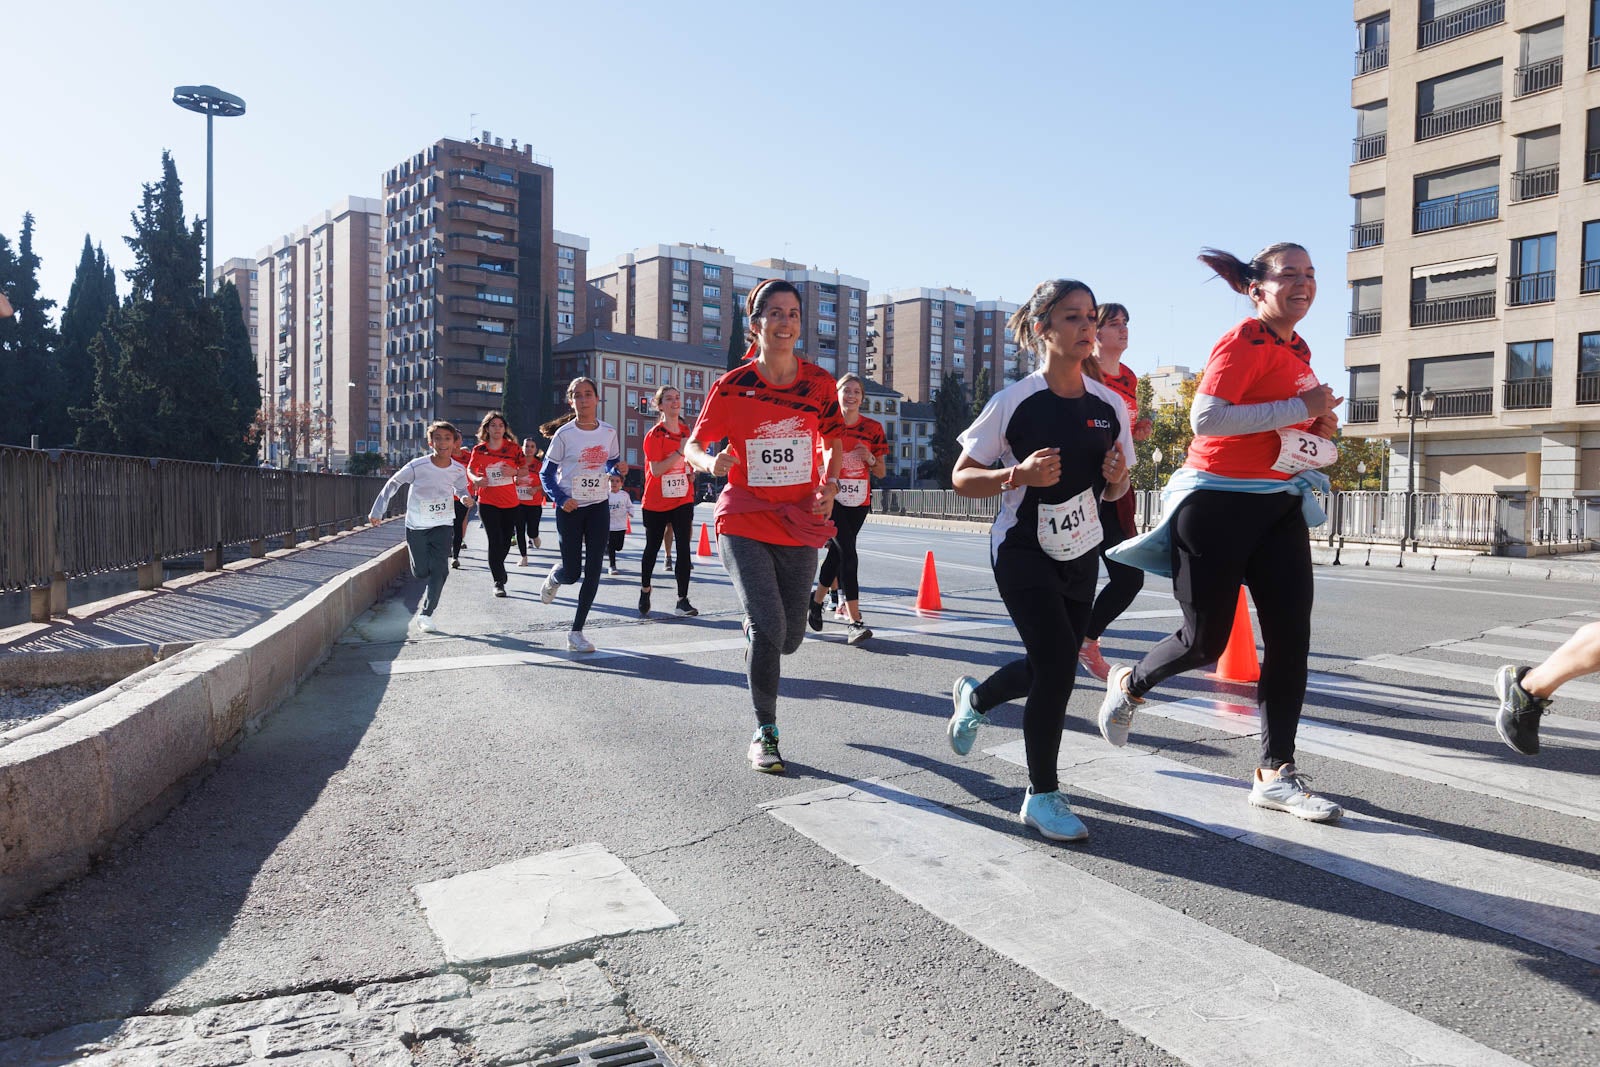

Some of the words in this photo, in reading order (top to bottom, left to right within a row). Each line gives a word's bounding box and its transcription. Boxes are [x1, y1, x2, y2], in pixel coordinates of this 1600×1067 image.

[1298, 438, 1318, 457] 23
[761, 448, 794, 464] 658
[581, 478, 600, 488] 352
[667, 479, 685, 487] 1378
[841, 484, 859, 493] 954
[429, 503, 446, 512] 353
[1048, 505, 1085, 534] 1431
